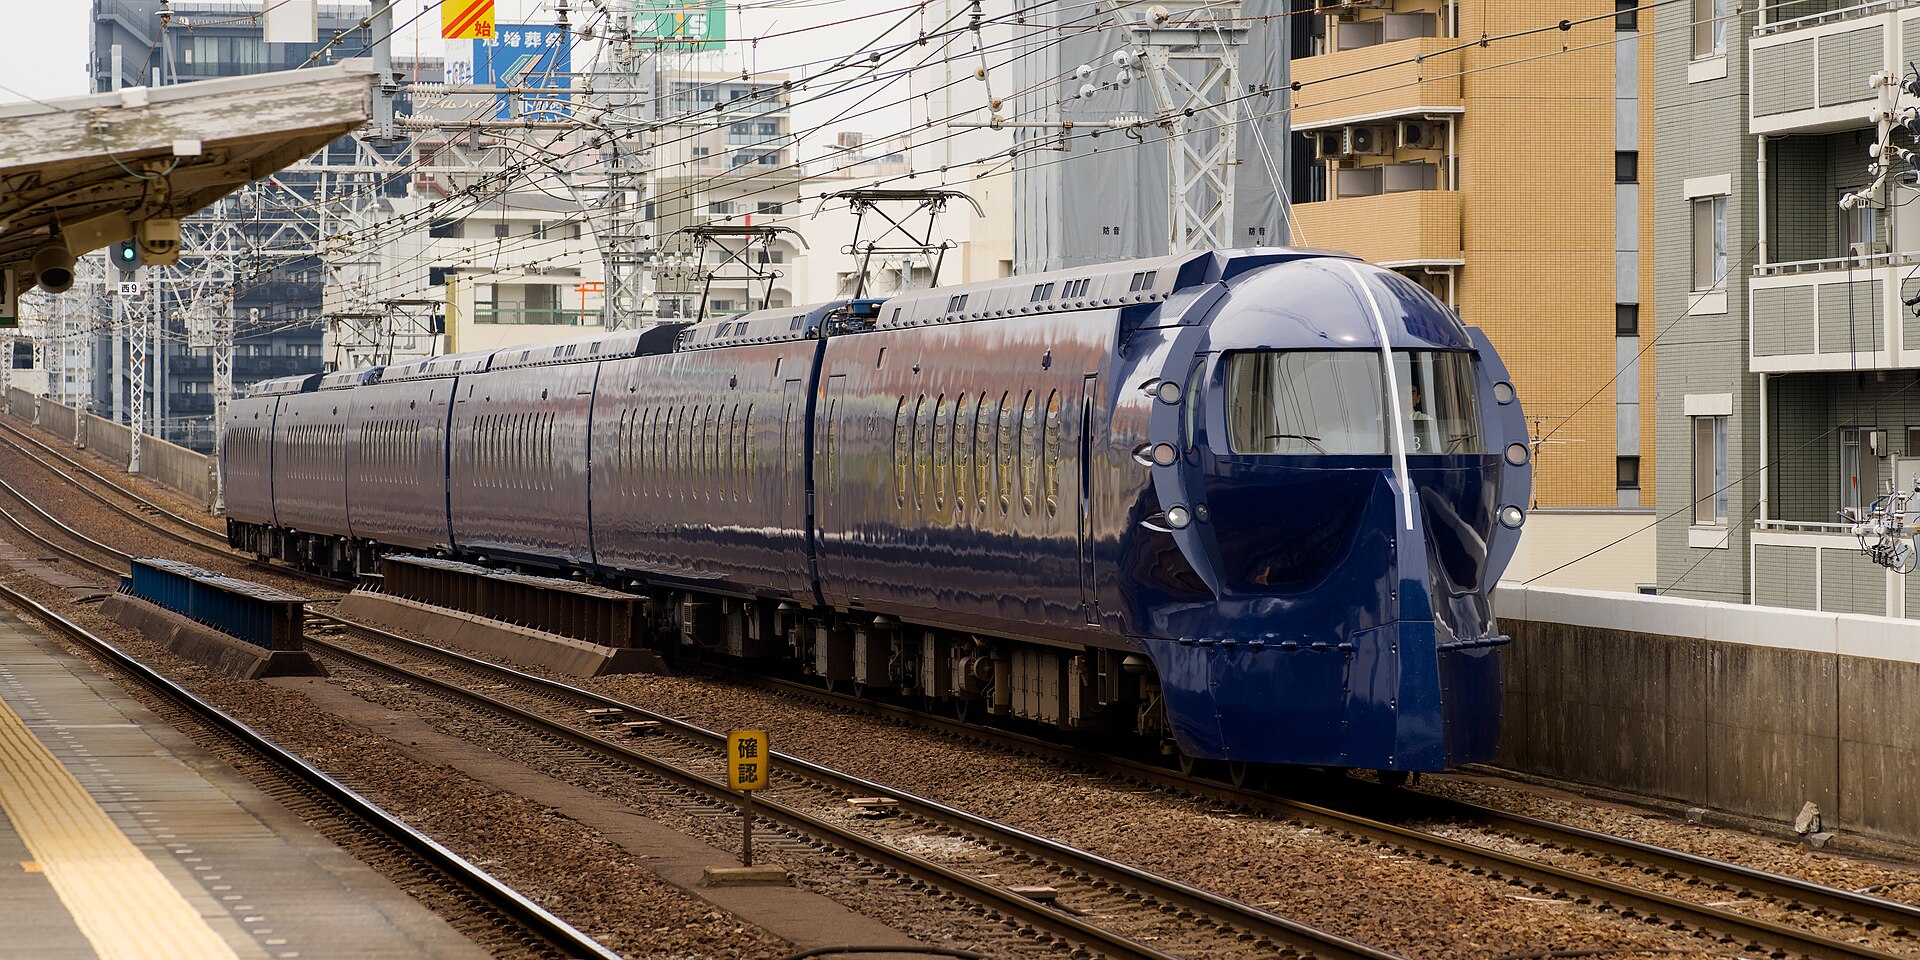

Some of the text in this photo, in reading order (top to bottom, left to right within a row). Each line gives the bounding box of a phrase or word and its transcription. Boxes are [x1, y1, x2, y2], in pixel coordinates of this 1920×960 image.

[475, 21, 491, 37] 始
[1103, 226, 1120, 235] 防音
[1248, 227, 1265, 236] 防音
[121, 284, 137, 293] 西9
[1412, 436, 1421, 450] 3
[738, 737, 758, 784] 確認
